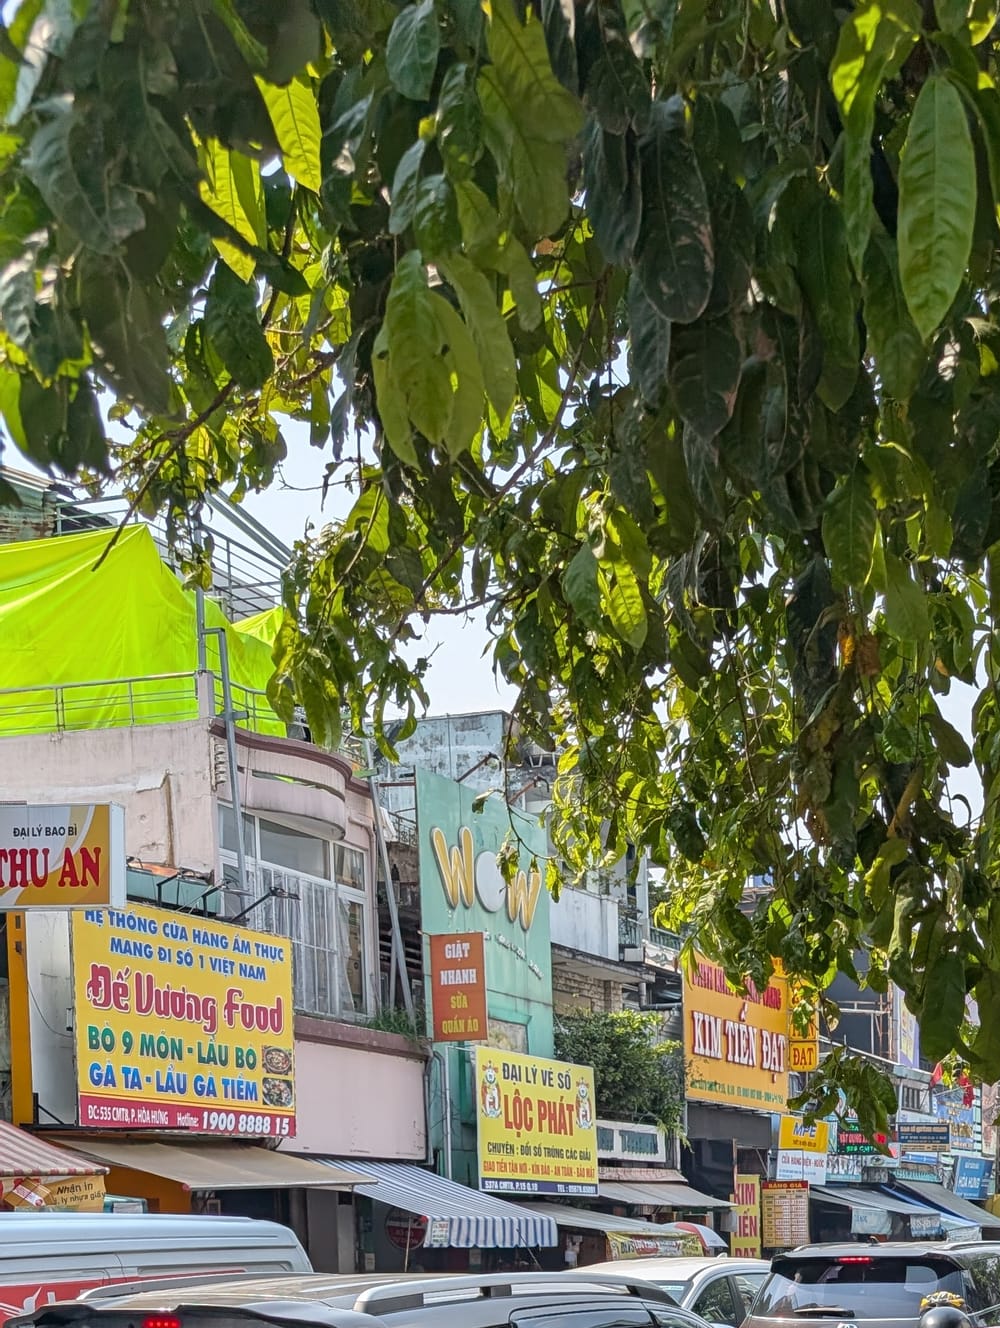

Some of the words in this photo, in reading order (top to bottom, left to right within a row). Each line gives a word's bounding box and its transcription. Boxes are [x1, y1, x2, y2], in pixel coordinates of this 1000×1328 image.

[13, 827, 30, 840] ĐẠI
[31, 824, 43, 837] LÝ
[45, 826, 66, 837] BAO
[67, 824, 78, 836] BÌ
[58, 847, 101, 888] AN
[108, 911, 158, 935] THỐNG
[162, 919, 189, 942] CỬA
[192, 927, 229, 950] HÀNG
[254, 942, 284, 965] THỰC
[110, 937, 153, 959] MANG
[158, 947, 172, 963] ĐI
[176, 949, 194, 967] SỐ
[198, 955, 205, 969] 1
[209, 956, 235, 977] VIỆT
[239, 963, 266, 981] NAM
[440, 968, 477, 985] NHANH
[467, 1016, 479, 1032] ÁO
[87, 1022, 116, 1053] BÒ
[121, 1030, 133, 1054] 9
[140, 1030, 184, 1061] MÓN
[197, 1033, 229, 1067] LẨU
[235, 1044, 257, 1070] BÒ
[691, 1010, 722, 1060] KIM
[761, 1029, 785, 1084] ĐẠT
[793, 1048, 814, 1069] ĐẠT
[89, 1060, 116, 1088] GÀ
[122, 1066, 143, 1090] TA
[156, 1064, 187, 1095] LẨU
[193, 1072, 217, 1098] GÀ
[502, 1062, 522, 1085] ĐẠI
[525, 1064, 538, 1085] LÝ
[541, 1067, 554, 1088] VÉ
[557, 1068, 571, 1090] SỐ
[202, 1111, 235, 1131] 1900
[238, 1115, 270, 1134] 8888
[275, 1118, 289, 1136] 15
[503, 1088, 533, 1138] LỘC
[537, 1096, 574, 1137] PHÁT
[487, 1141, 515, 1155] CHUYÊN
[56, 1183, 82, 1195] Nhận
[734, 1183, 756, 1205] KIM
[734, 1208, 757, 1238] IẾN
